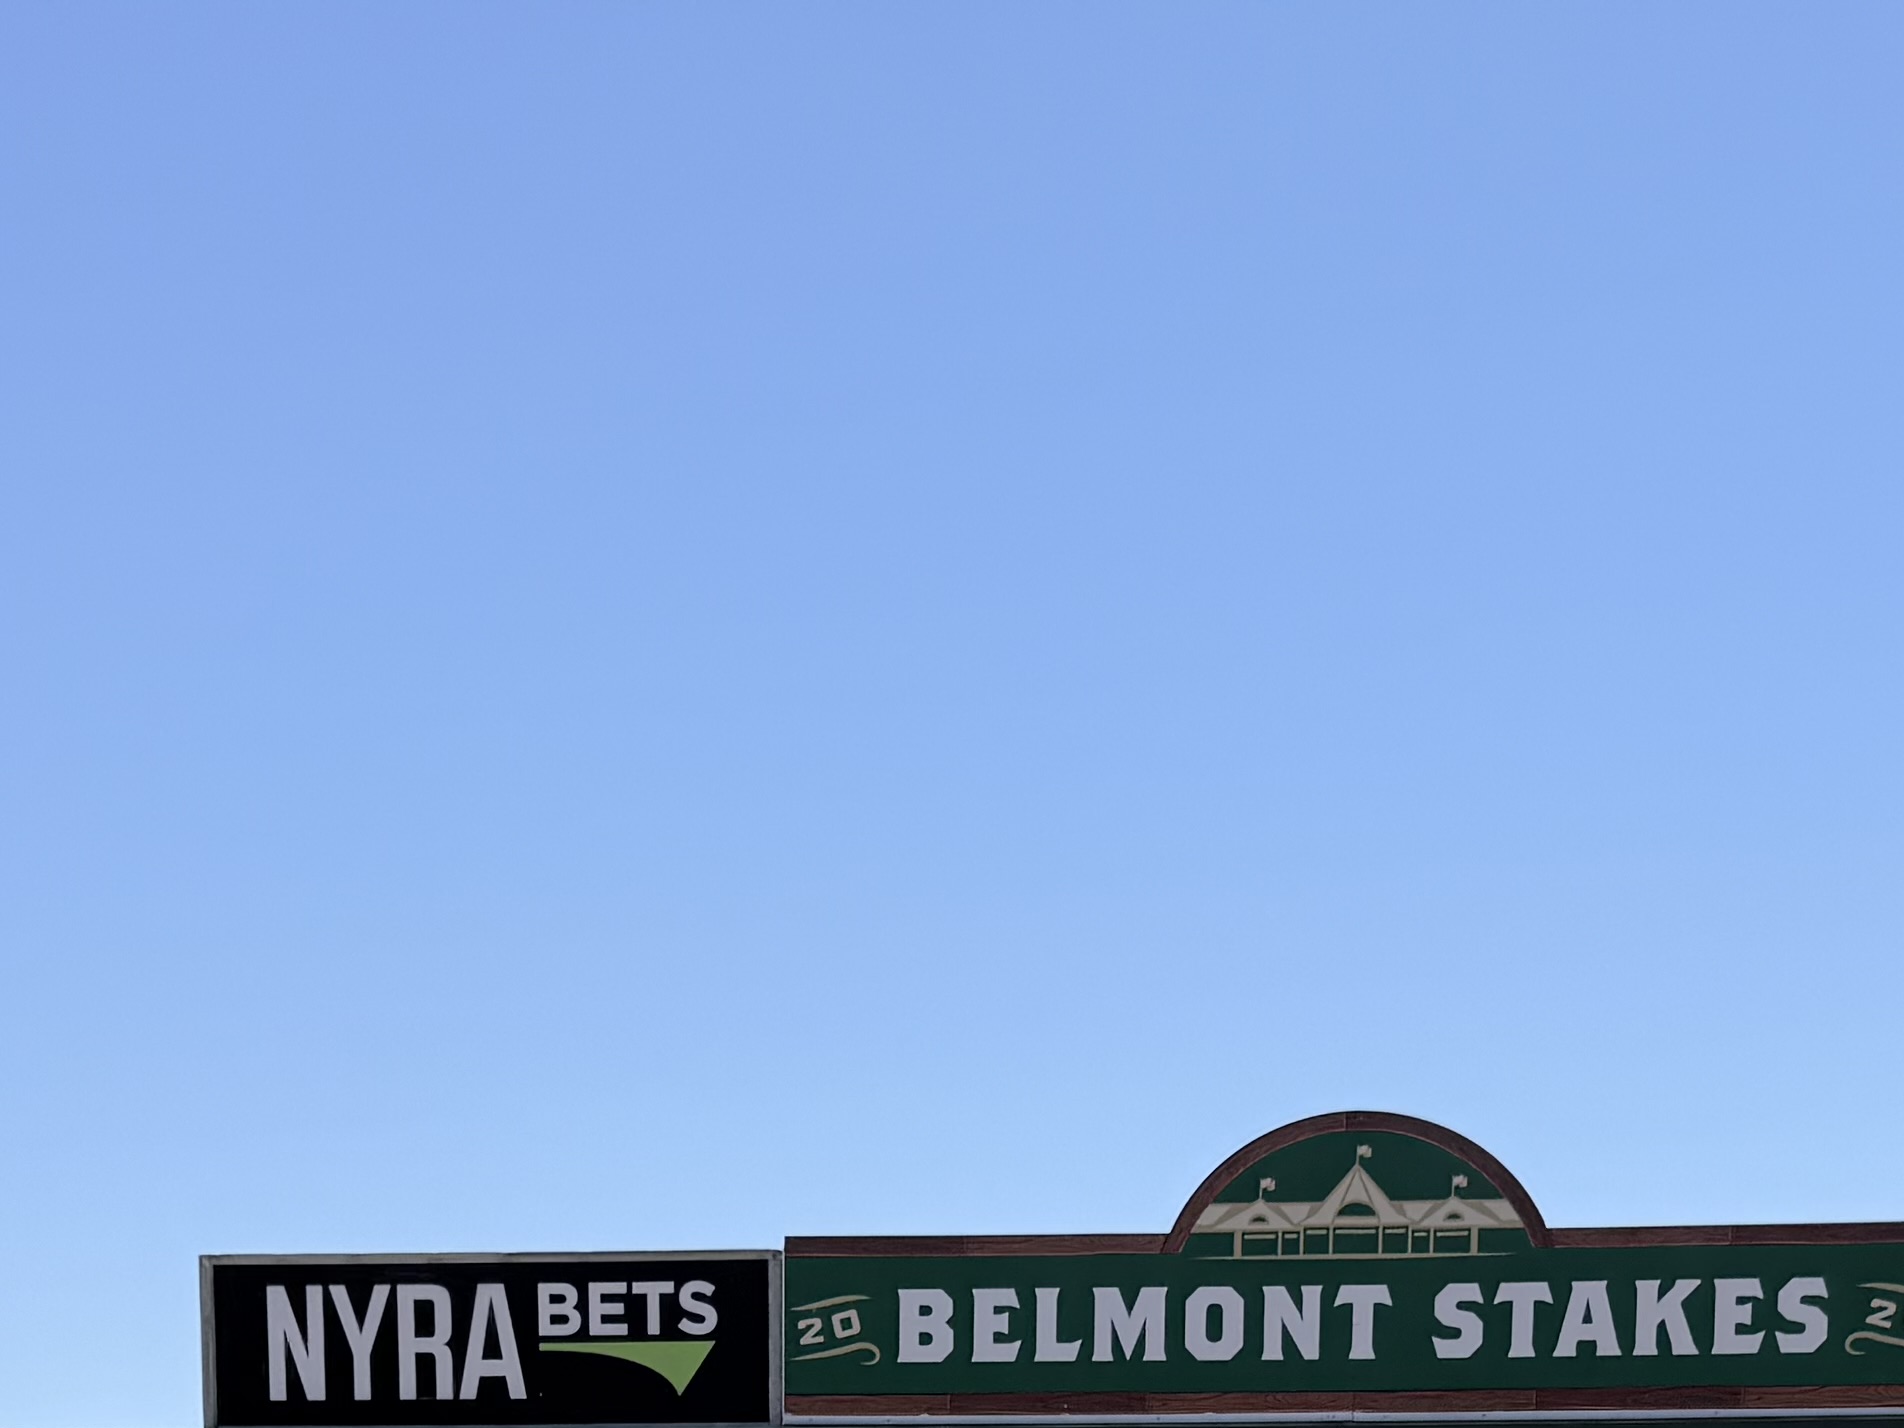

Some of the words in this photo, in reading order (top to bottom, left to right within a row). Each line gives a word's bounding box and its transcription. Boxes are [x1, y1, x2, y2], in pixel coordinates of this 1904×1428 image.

[267, 1283, 528, 1402] NYRA
[538, 1279, 718, 1337] BETS
[796, 1308, 863, 1347] 20
[897, 1283, 1393, 1364] BELMONT
[1432, 1275, 1830, 1361] STAKES
